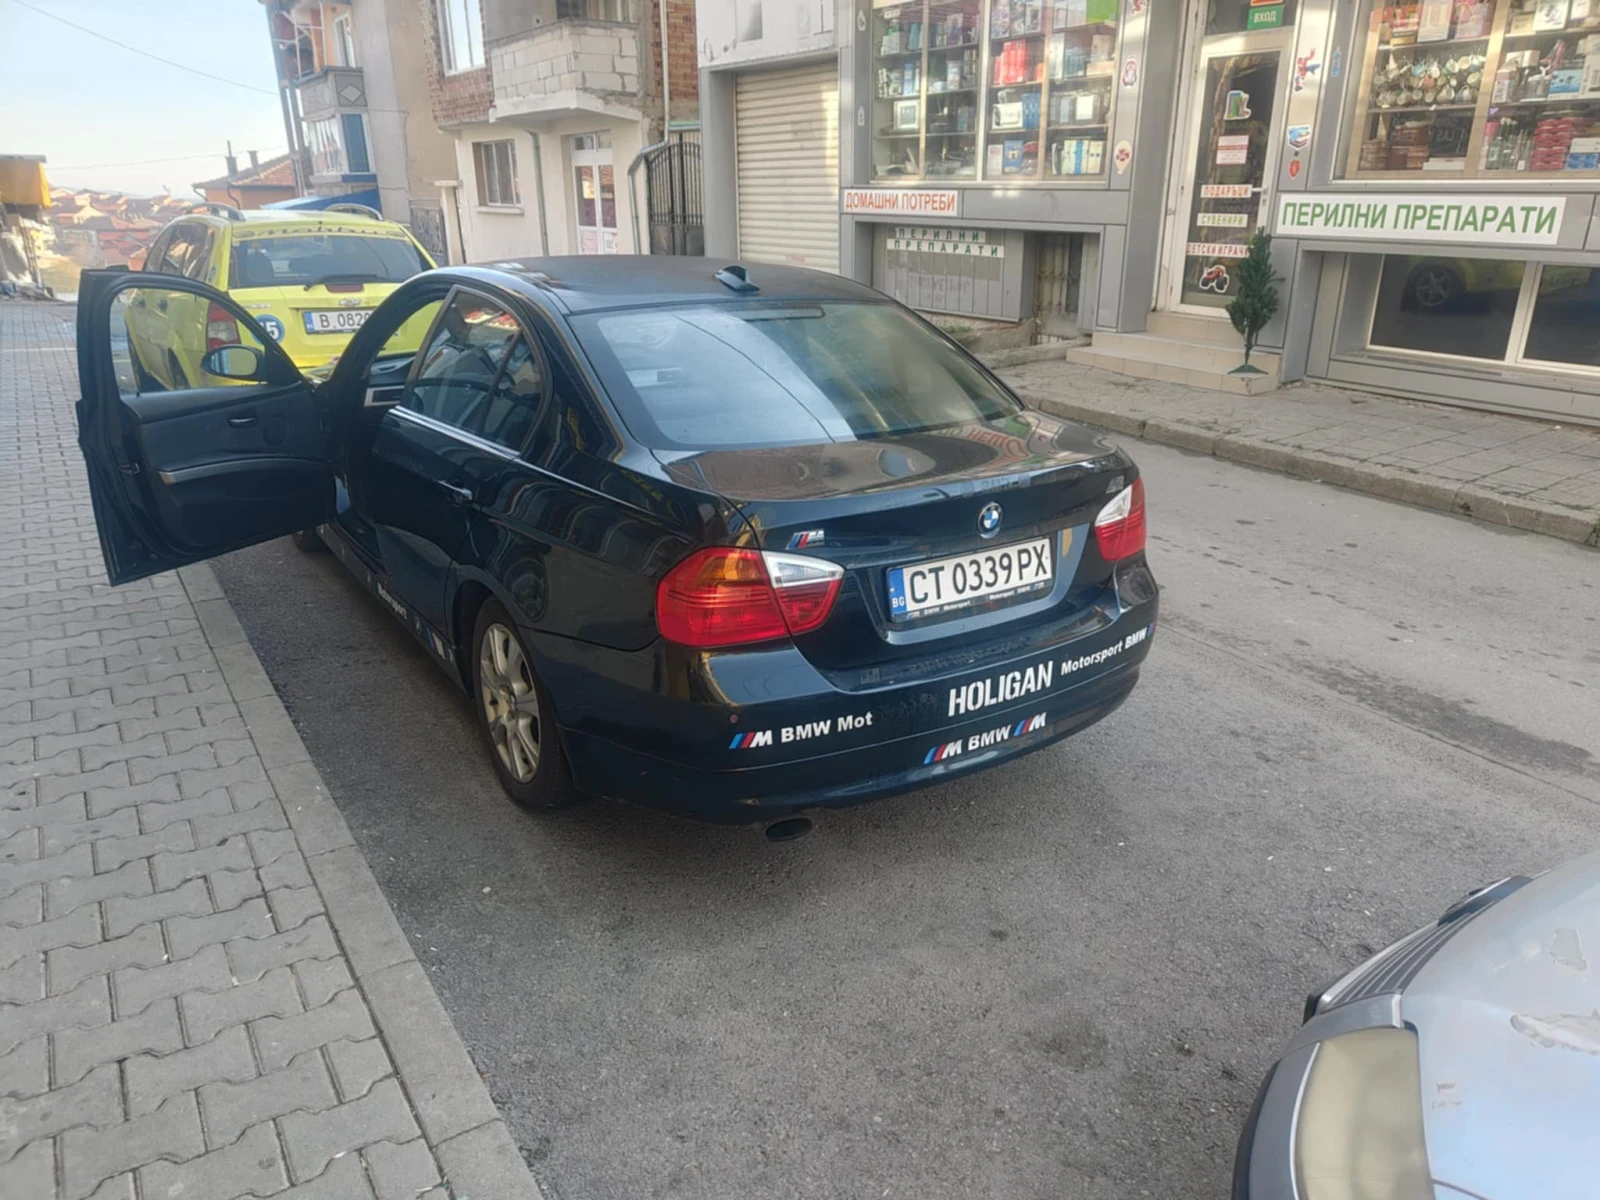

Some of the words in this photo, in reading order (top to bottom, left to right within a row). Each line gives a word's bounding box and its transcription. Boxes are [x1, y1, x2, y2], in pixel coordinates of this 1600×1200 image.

[1254, 10, 1277, 23] ВХОД
[846, 192, 899, 210] ДОМАШНИ
[902, 193, 956, 211] ПОТРЕБИ
[1282, 202, 1388, 229] ПЕРИЛНИ
[1393, 204, 1558, 234] ПРЕПАРАТИ
[899, 228, 979, 242] ПЕРИЛНИ
[894, 240, 998, 256] ПРЕПАРАТИ
[319, 314, 331, 329] B
[909, 566, 945, 604] CT
[952, 552, 1013, 595] 0339
[1017, 544, 1048, 581] PX
[891, 596, 905, 608] BG
[1060, 640, 1123, 676] Motorsport
[1124, 626, 1147, 650] BMW
[948, 660, 1054, 717] HOLIGAN
[781, 719, 831, 743] BMW
[837, 711, 873, 732] Mot
[968, 724, 1012, 751] BMW
